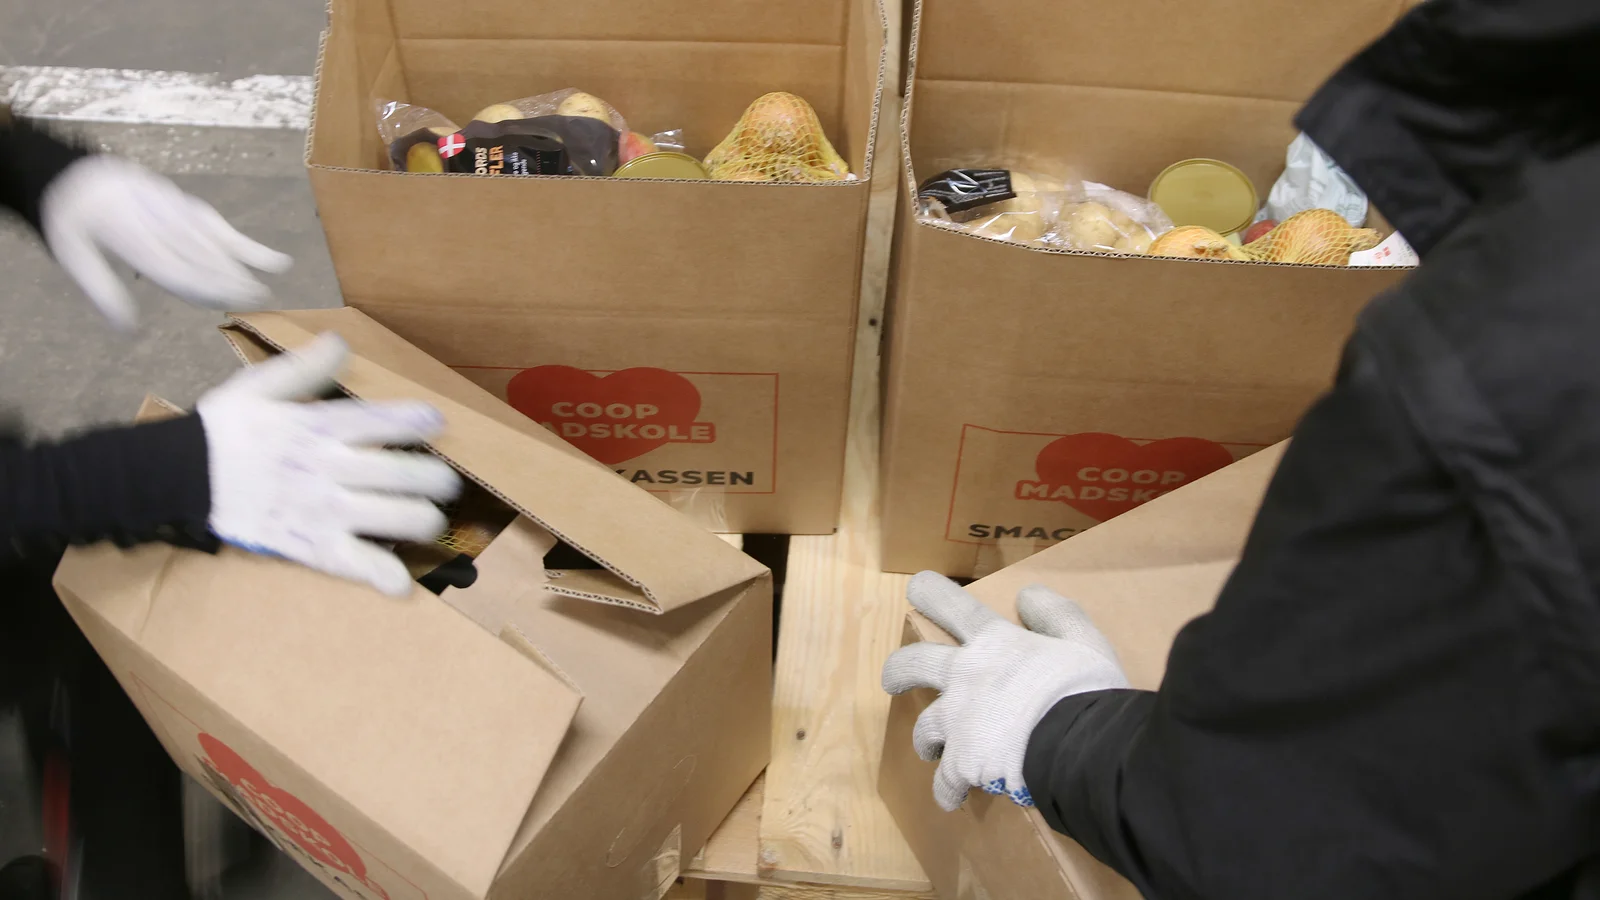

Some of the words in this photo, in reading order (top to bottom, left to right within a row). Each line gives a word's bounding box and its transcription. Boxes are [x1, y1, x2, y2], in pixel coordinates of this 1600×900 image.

[551, 402, 659, 419] COOP
[616, 469, 754, 486] ASSEN
[1077, 467, 1187, 485] COOP
[1019, 483, 1172, 502] MADSK
